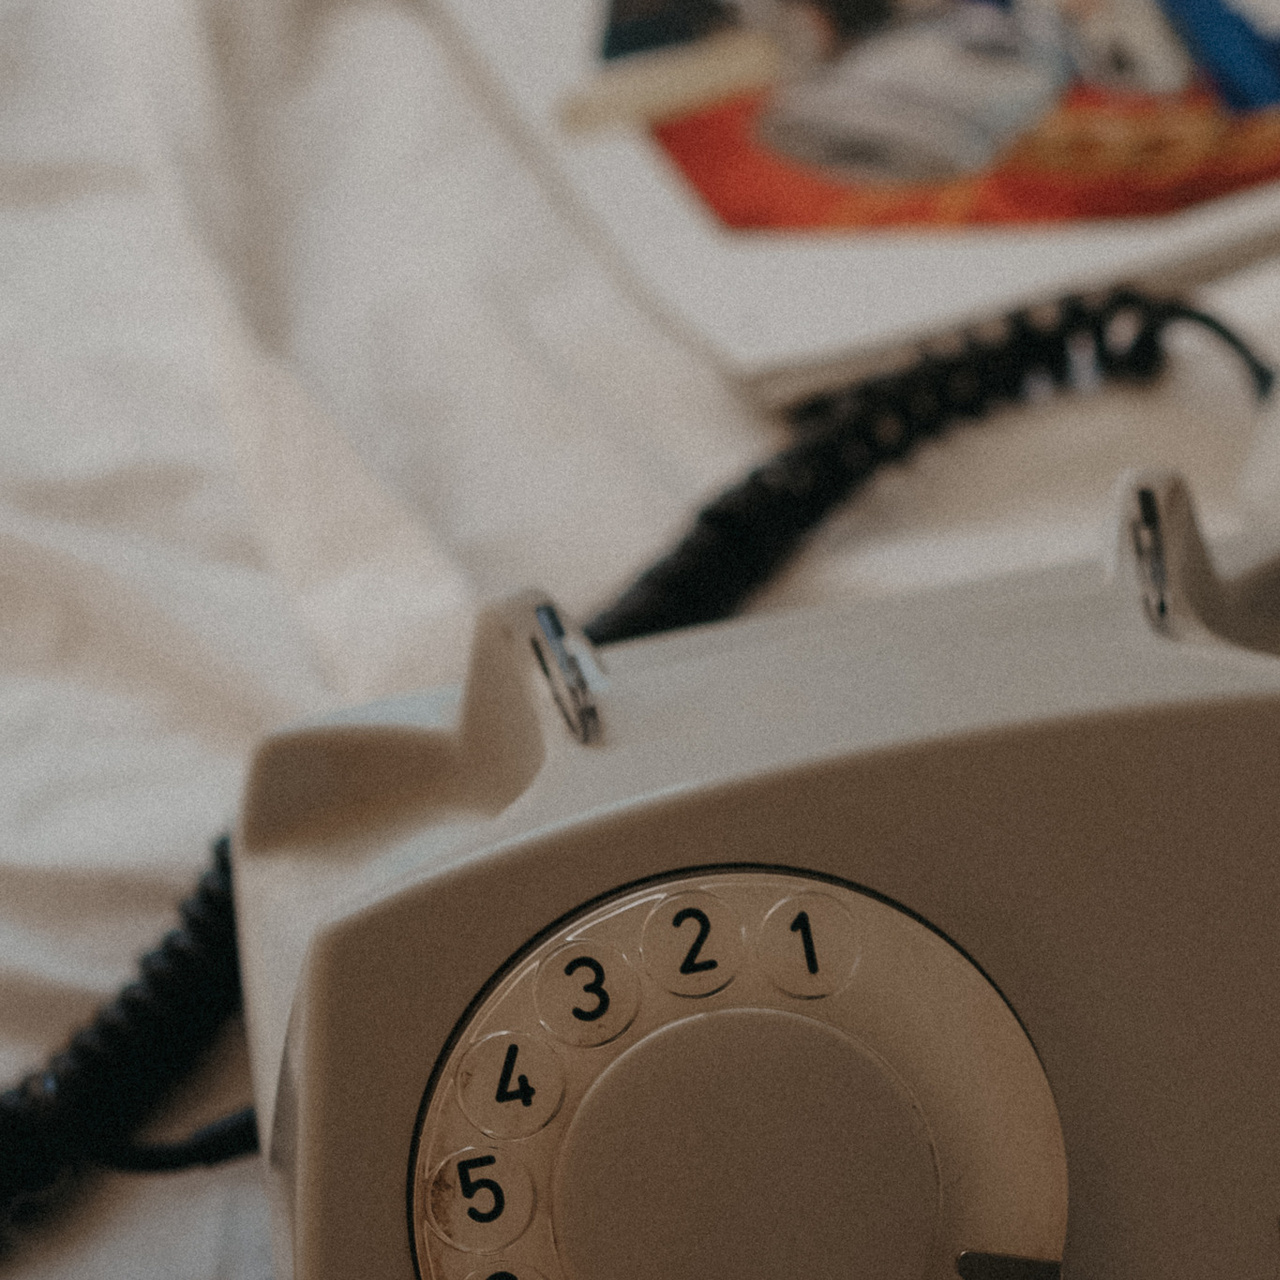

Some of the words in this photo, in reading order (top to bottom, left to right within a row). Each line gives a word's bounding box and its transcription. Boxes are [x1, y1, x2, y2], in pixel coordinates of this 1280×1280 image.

[672, 907, 718, 976] 2
[789, 911, 819, 975] 1
[563, 956, 611, 1022] 3
[494, 1043, 536, 1107] 4
[456, 1154, 506, 1224] 5
